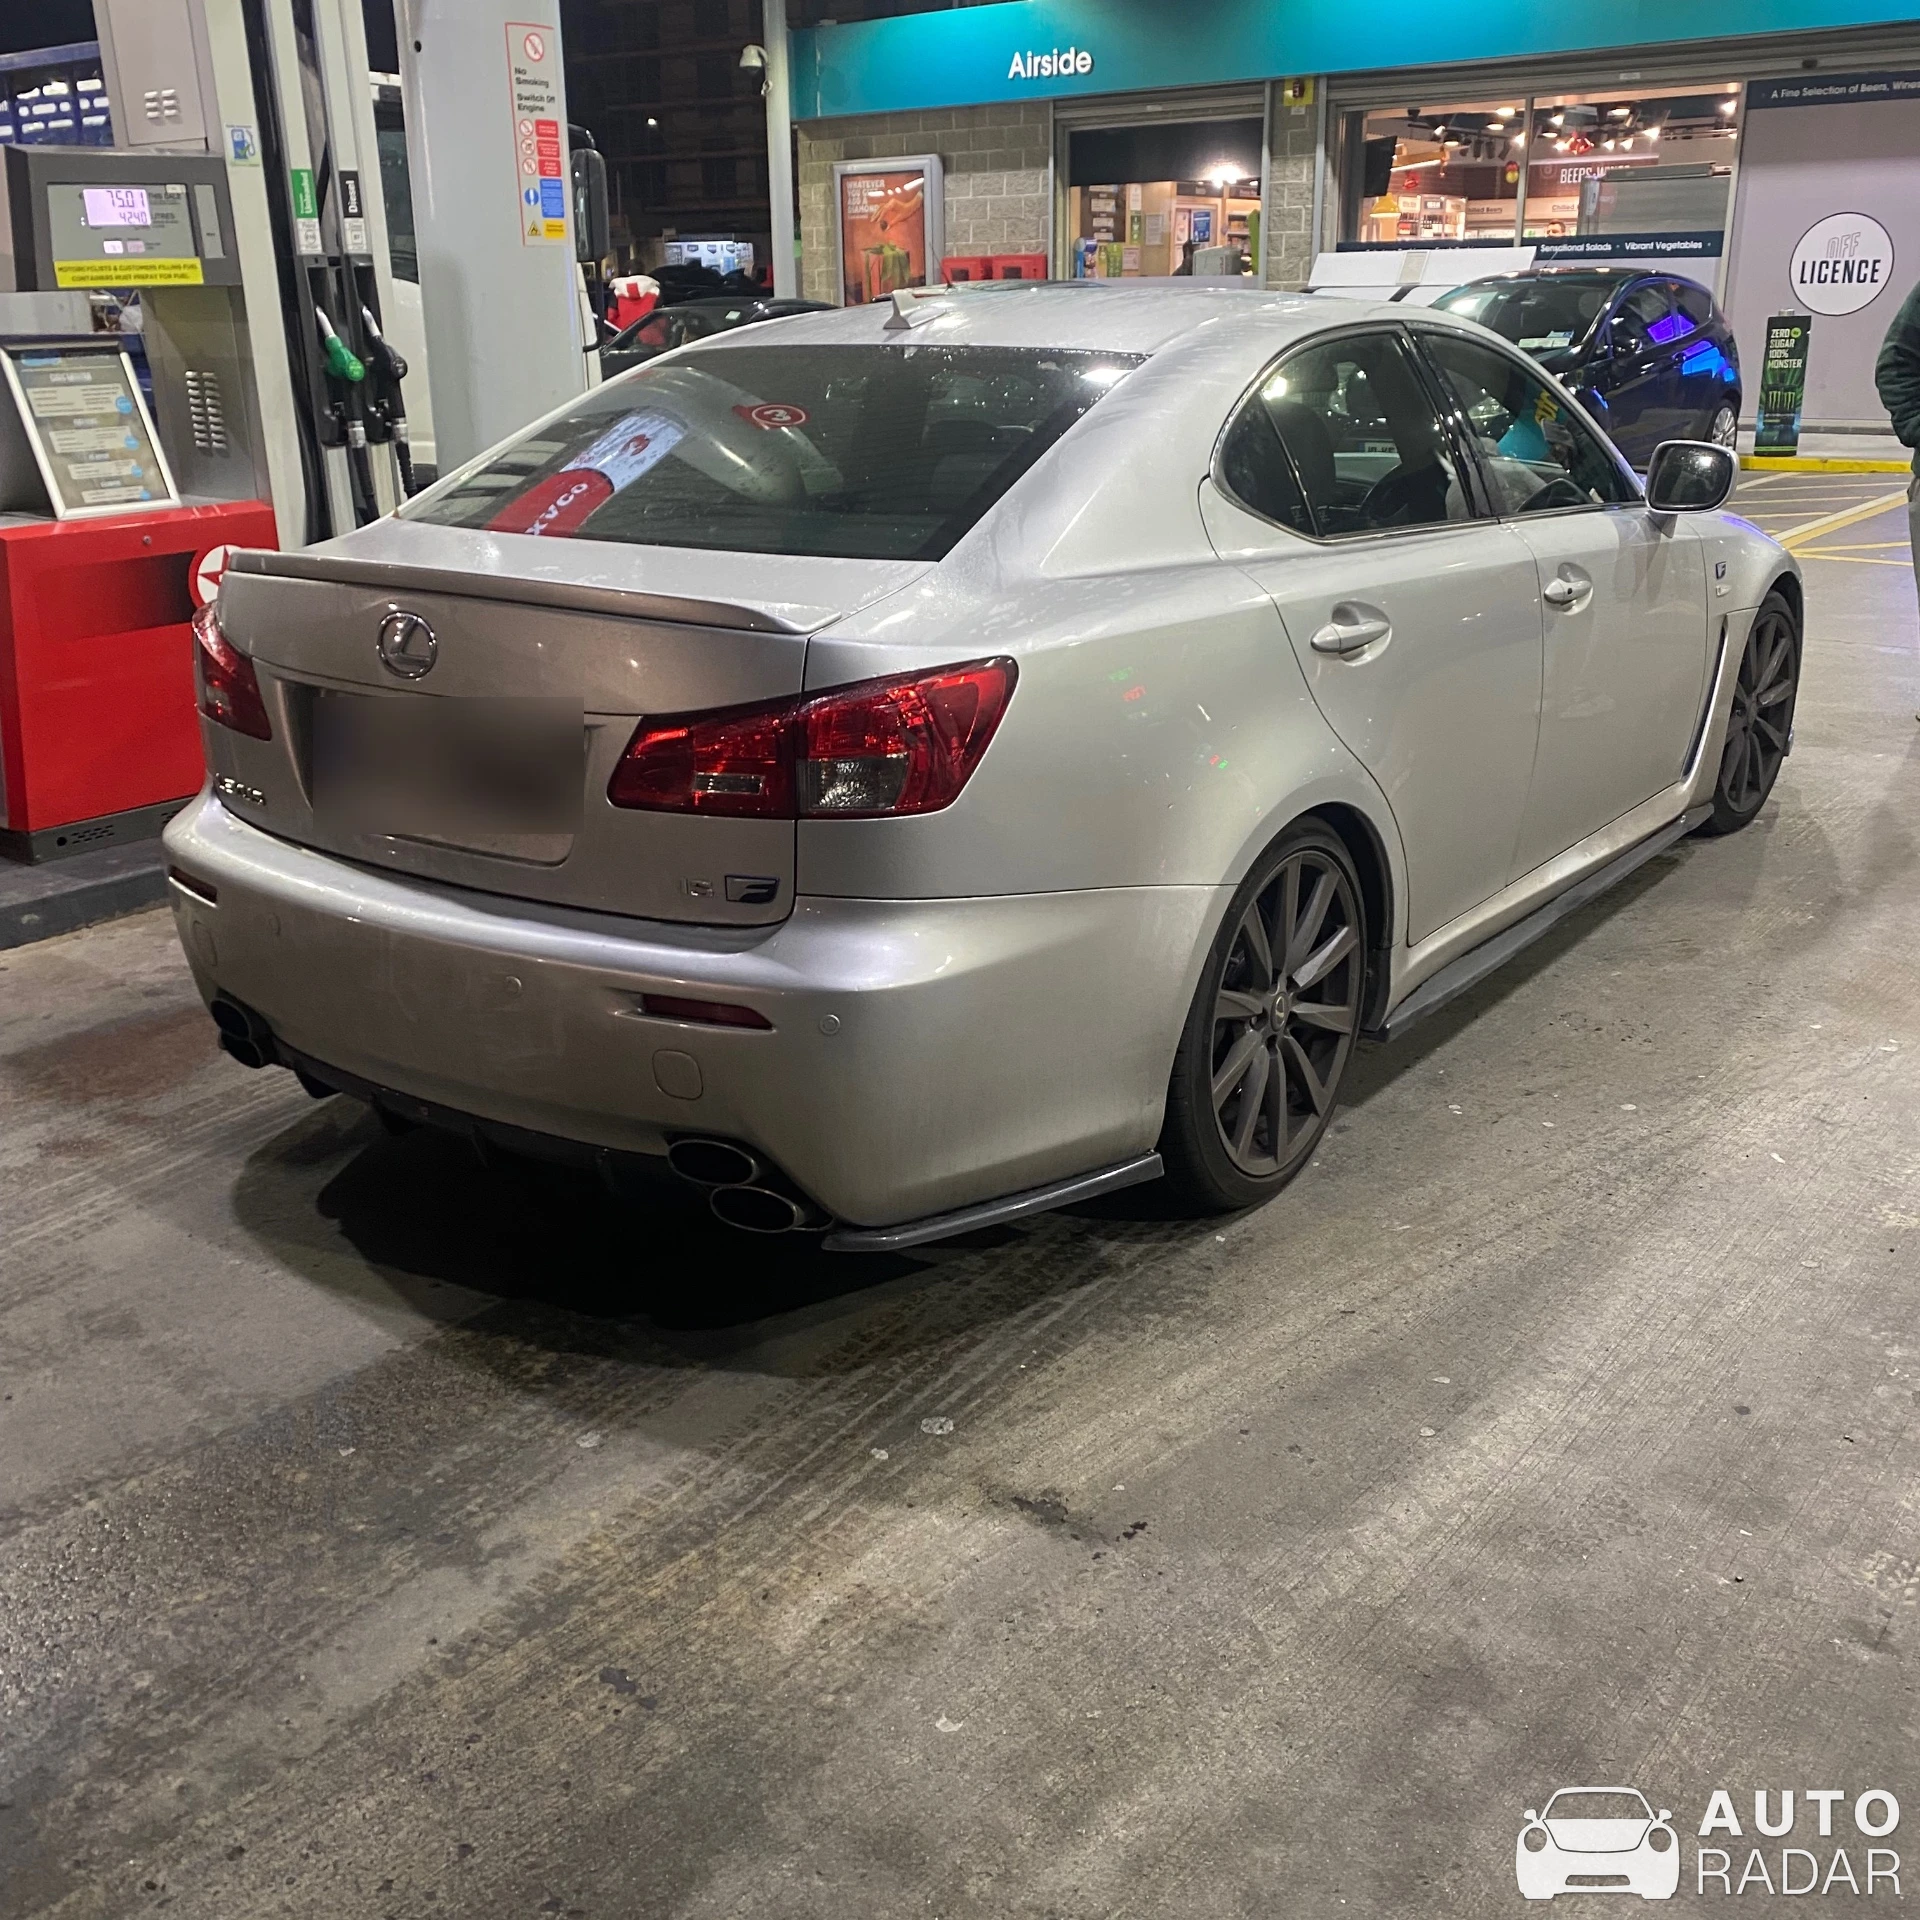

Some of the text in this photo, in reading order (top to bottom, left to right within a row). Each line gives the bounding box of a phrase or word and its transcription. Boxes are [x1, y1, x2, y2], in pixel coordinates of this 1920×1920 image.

[1008, 46, 1093, 79] Airside
[515, 67, 527, 75] No
[515, 77, 549, 88] Smoking
[1771, 90, 1779, 99] A
[1780, 88, 1800, 98] Fine
[1802, 86, 1847, 97] Selection
[1848, 84, 1859, 93] of
[517, 93, 545, 103] Switch
[518, 103, 545, 113] Engine
[847, 179, 885, 188] WHATEVER
[300, 172, 313, 214] Unleaded
[345, 180, 358, 212] Diesel
[1540, 241, 1703, 253] Sensational Salads Vibrant Vegetables
[1826, 231, 1861, 259] OFF
[1799, 259, 1881, 284] LICENCE
[1771, 328, 1790, 339] ZERO
[1769, 338, 1795, 349] SUGAR
[1769, 348, 1789, 359] 100%
[1767, 358, 1803, 369] MONSTER
